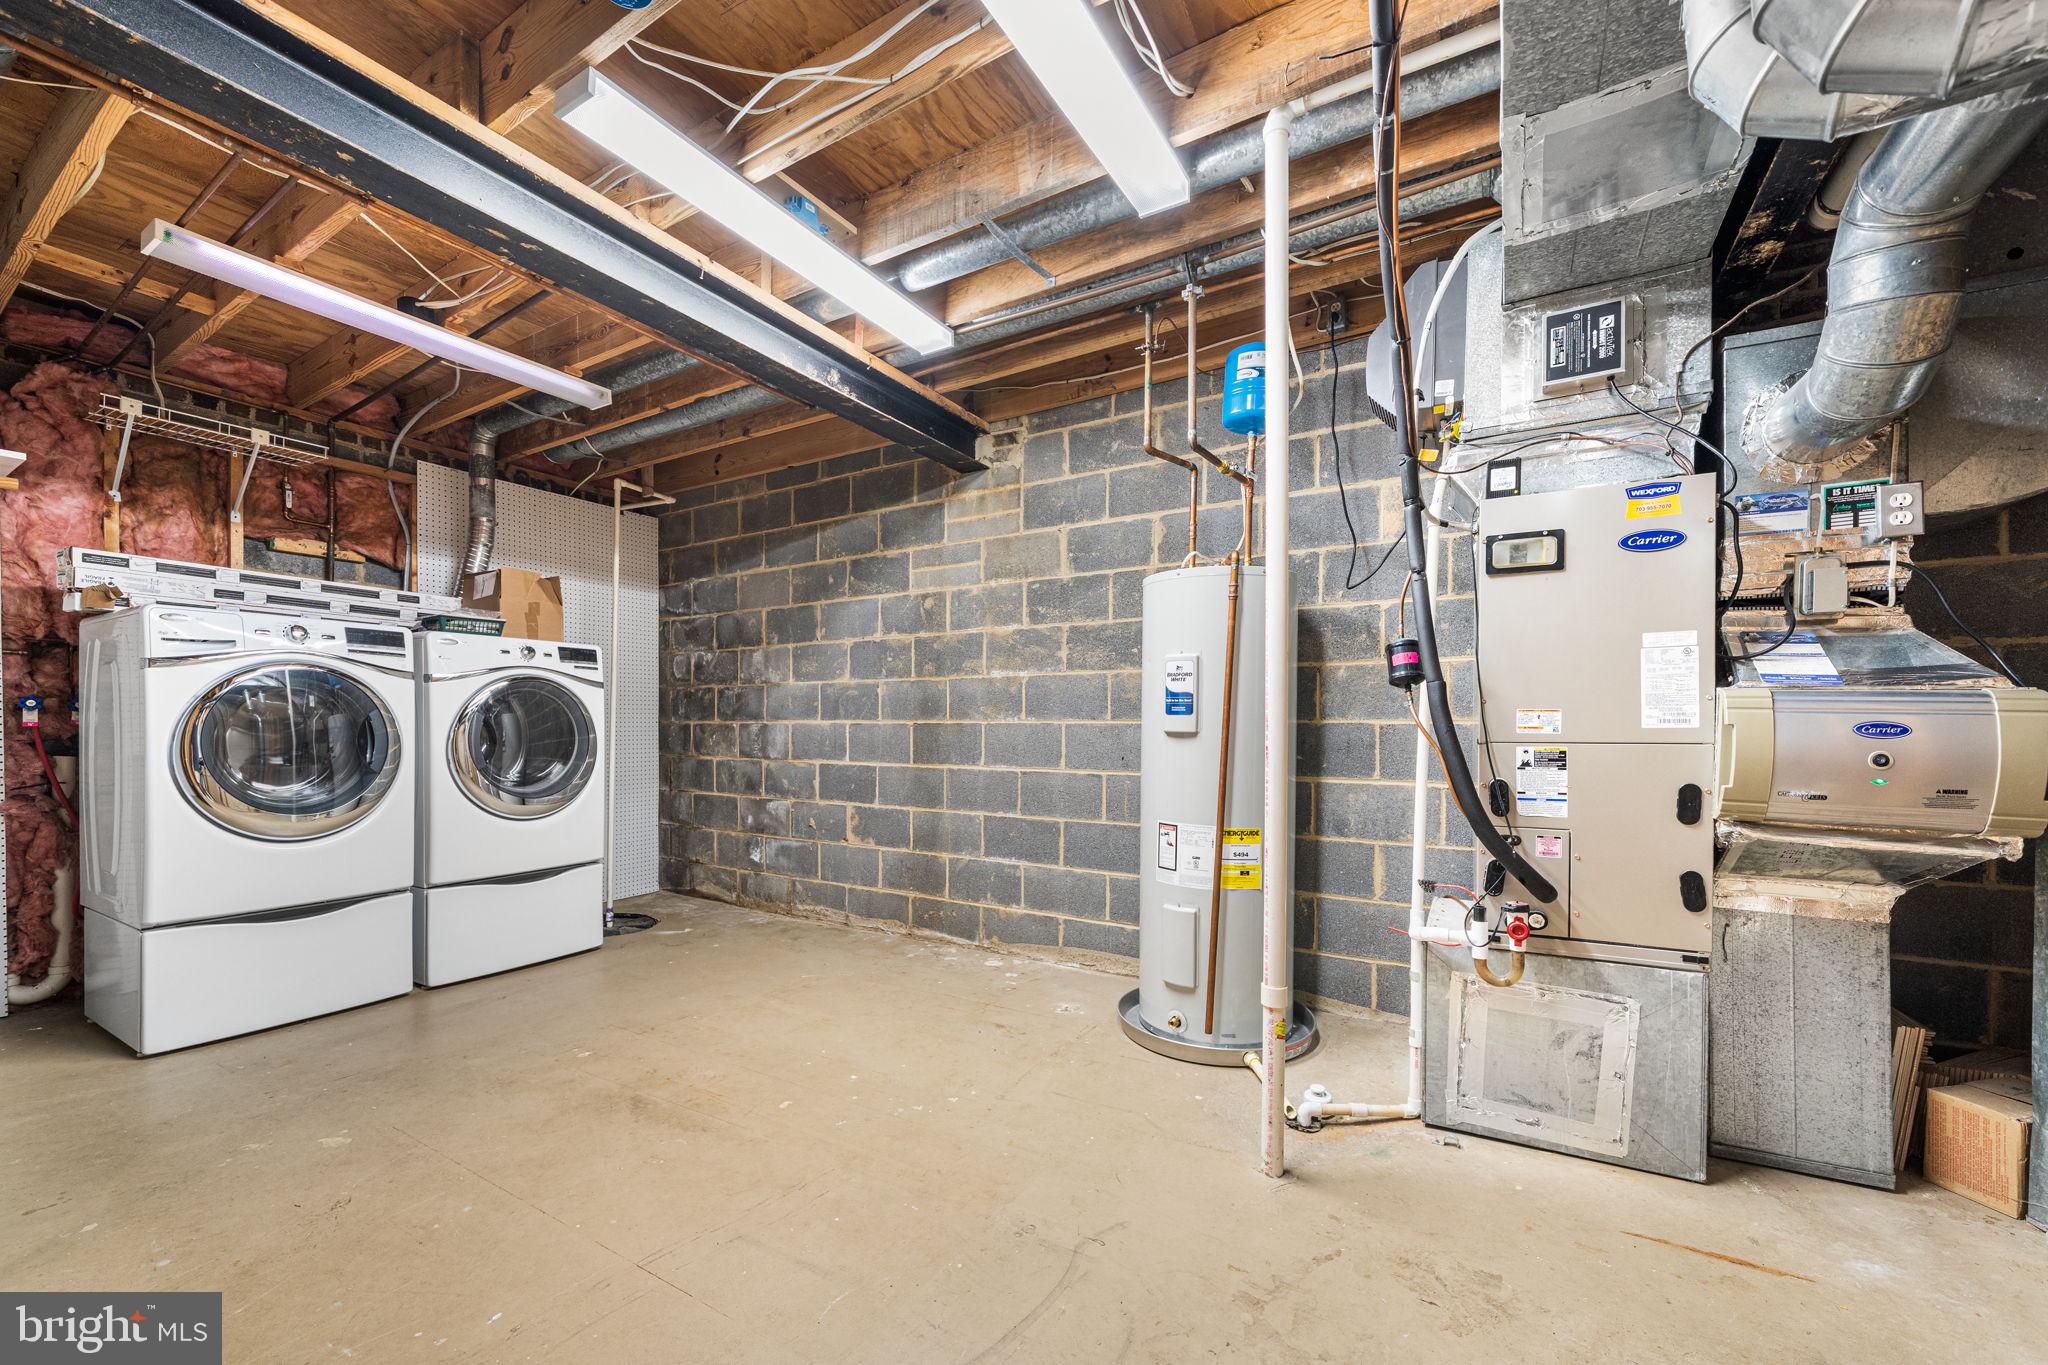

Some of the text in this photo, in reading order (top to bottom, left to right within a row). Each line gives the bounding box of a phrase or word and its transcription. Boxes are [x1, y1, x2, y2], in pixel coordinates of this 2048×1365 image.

[1606, 327, 1615, 357] activTek
[1631, 486, 1676, 496] WEXFORD
[1832, 488, 1841, 496] IS
[1843, 487, 1852, 495] IT
[1627, 534, 1678, 546] Carrier
[1861, 726, 1904, 734] Carrier
